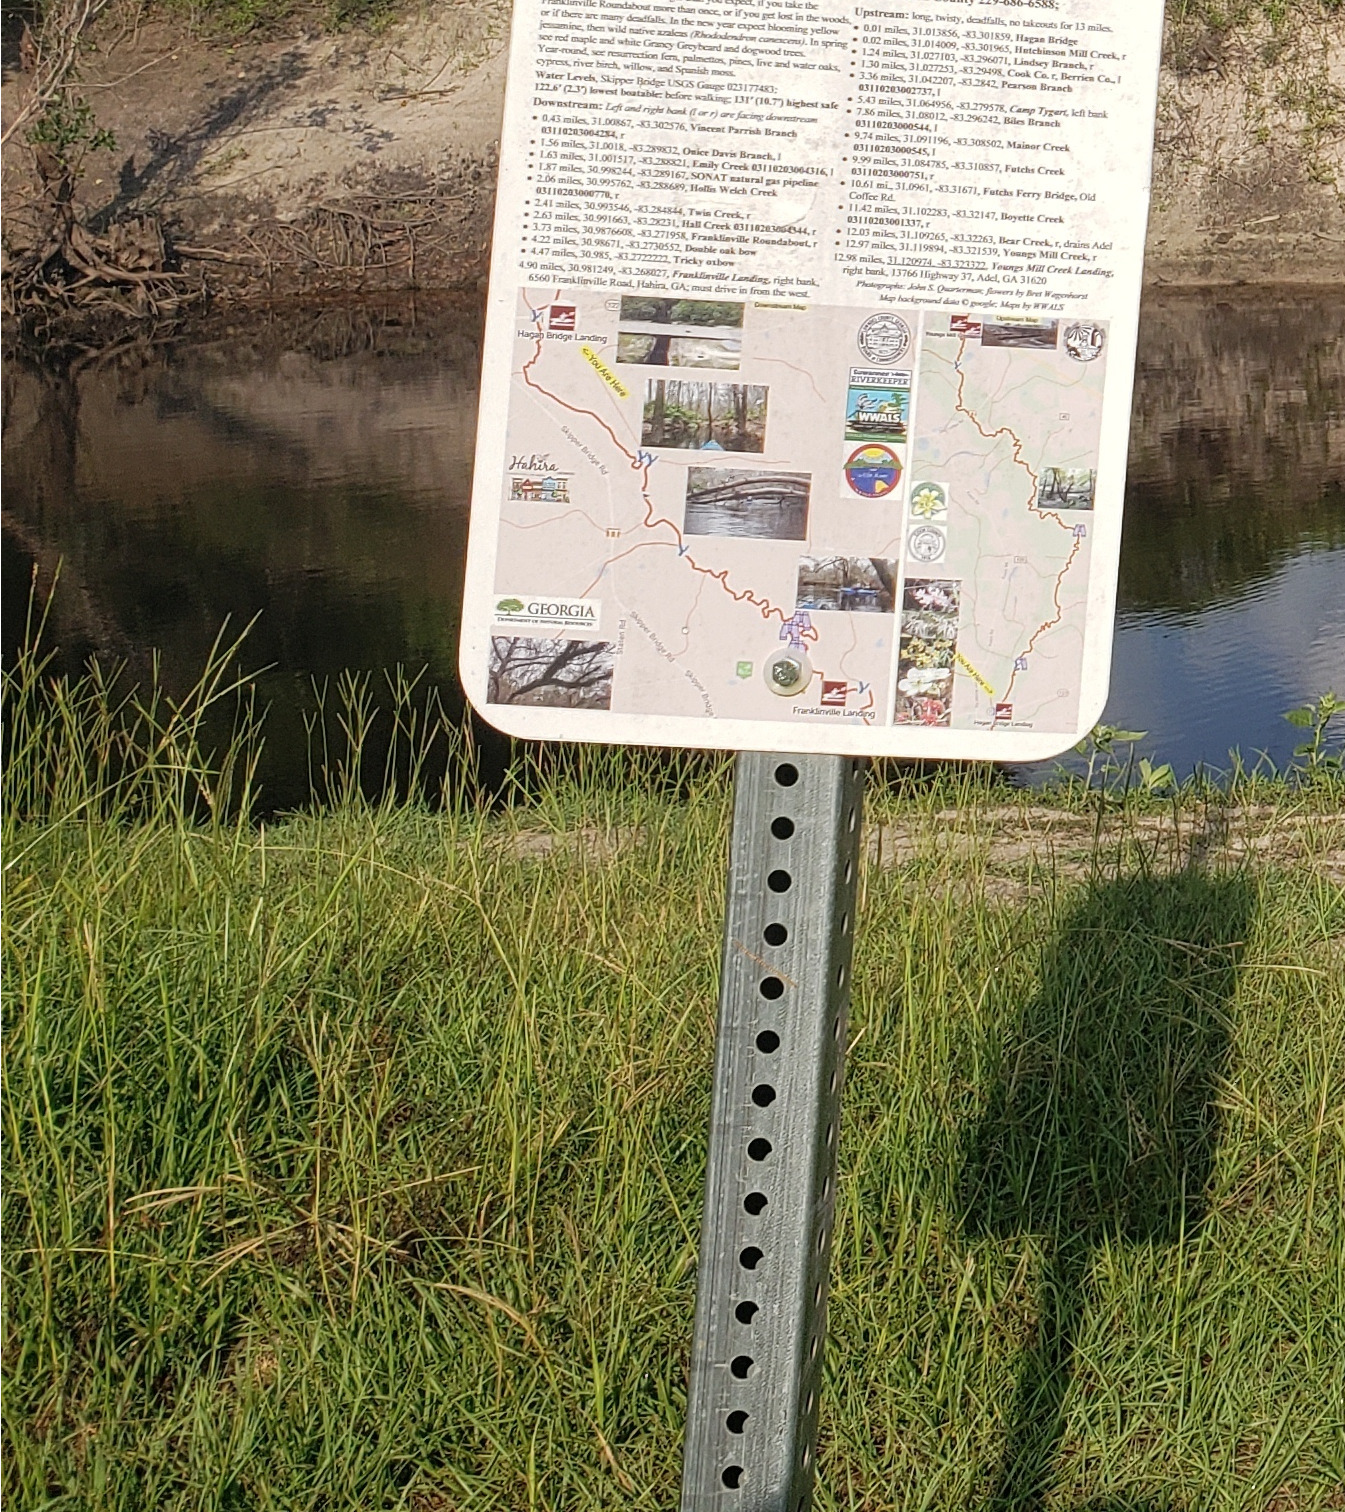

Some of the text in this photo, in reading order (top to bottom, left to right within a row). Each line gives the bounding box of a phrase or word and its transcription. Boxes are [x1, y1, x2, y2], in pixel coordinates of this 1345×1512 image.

[517, 330, 608, 345] Hagan Bridge Landing
[850, 375, 908, 385] RIVERKEEPER
[858, 411, 901, 423] WWALS
[508, 455, 559, 472] Hahira
[527, 602, 596, 620] GEORGIA
[792, 706, 876, 720] Franklinville Landing
